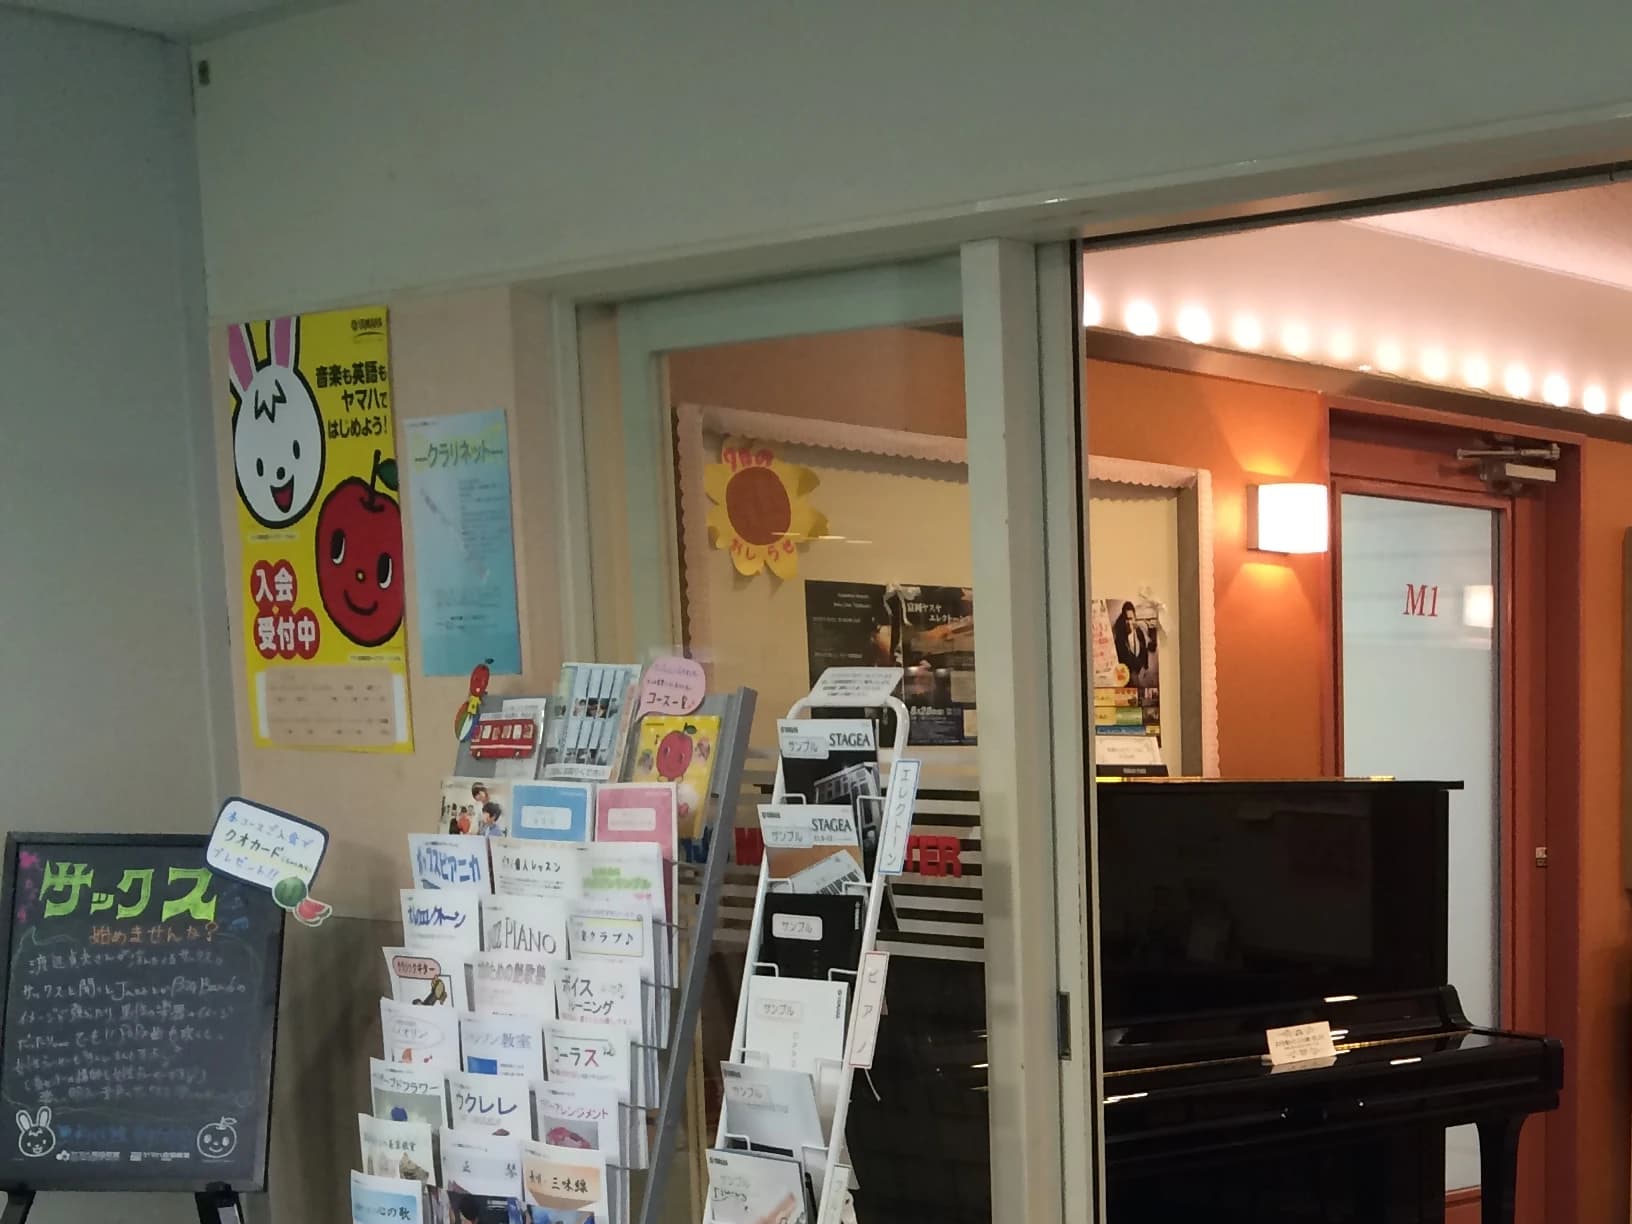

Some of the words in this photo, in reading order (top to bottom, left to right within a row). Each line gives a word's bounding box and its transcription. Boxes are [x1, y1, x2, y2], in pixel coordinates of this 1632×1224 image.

[315, 360, 388, 389] 音楽も英語も
[327, 415, 389, 440] はじめよう!
[254, 567, 295, 603] 入会
[1402, 583, 1438, 617] M1
[257, 615, 316, 651] 受付中
[828, 732, 871, 747] STAGEA
[811, 818, 853, 833] STAGEA
[224, 829, 285, 859] クオカード
[39, 859, 218, 923] サックス
[504, 917, 557, 955] PIANO
